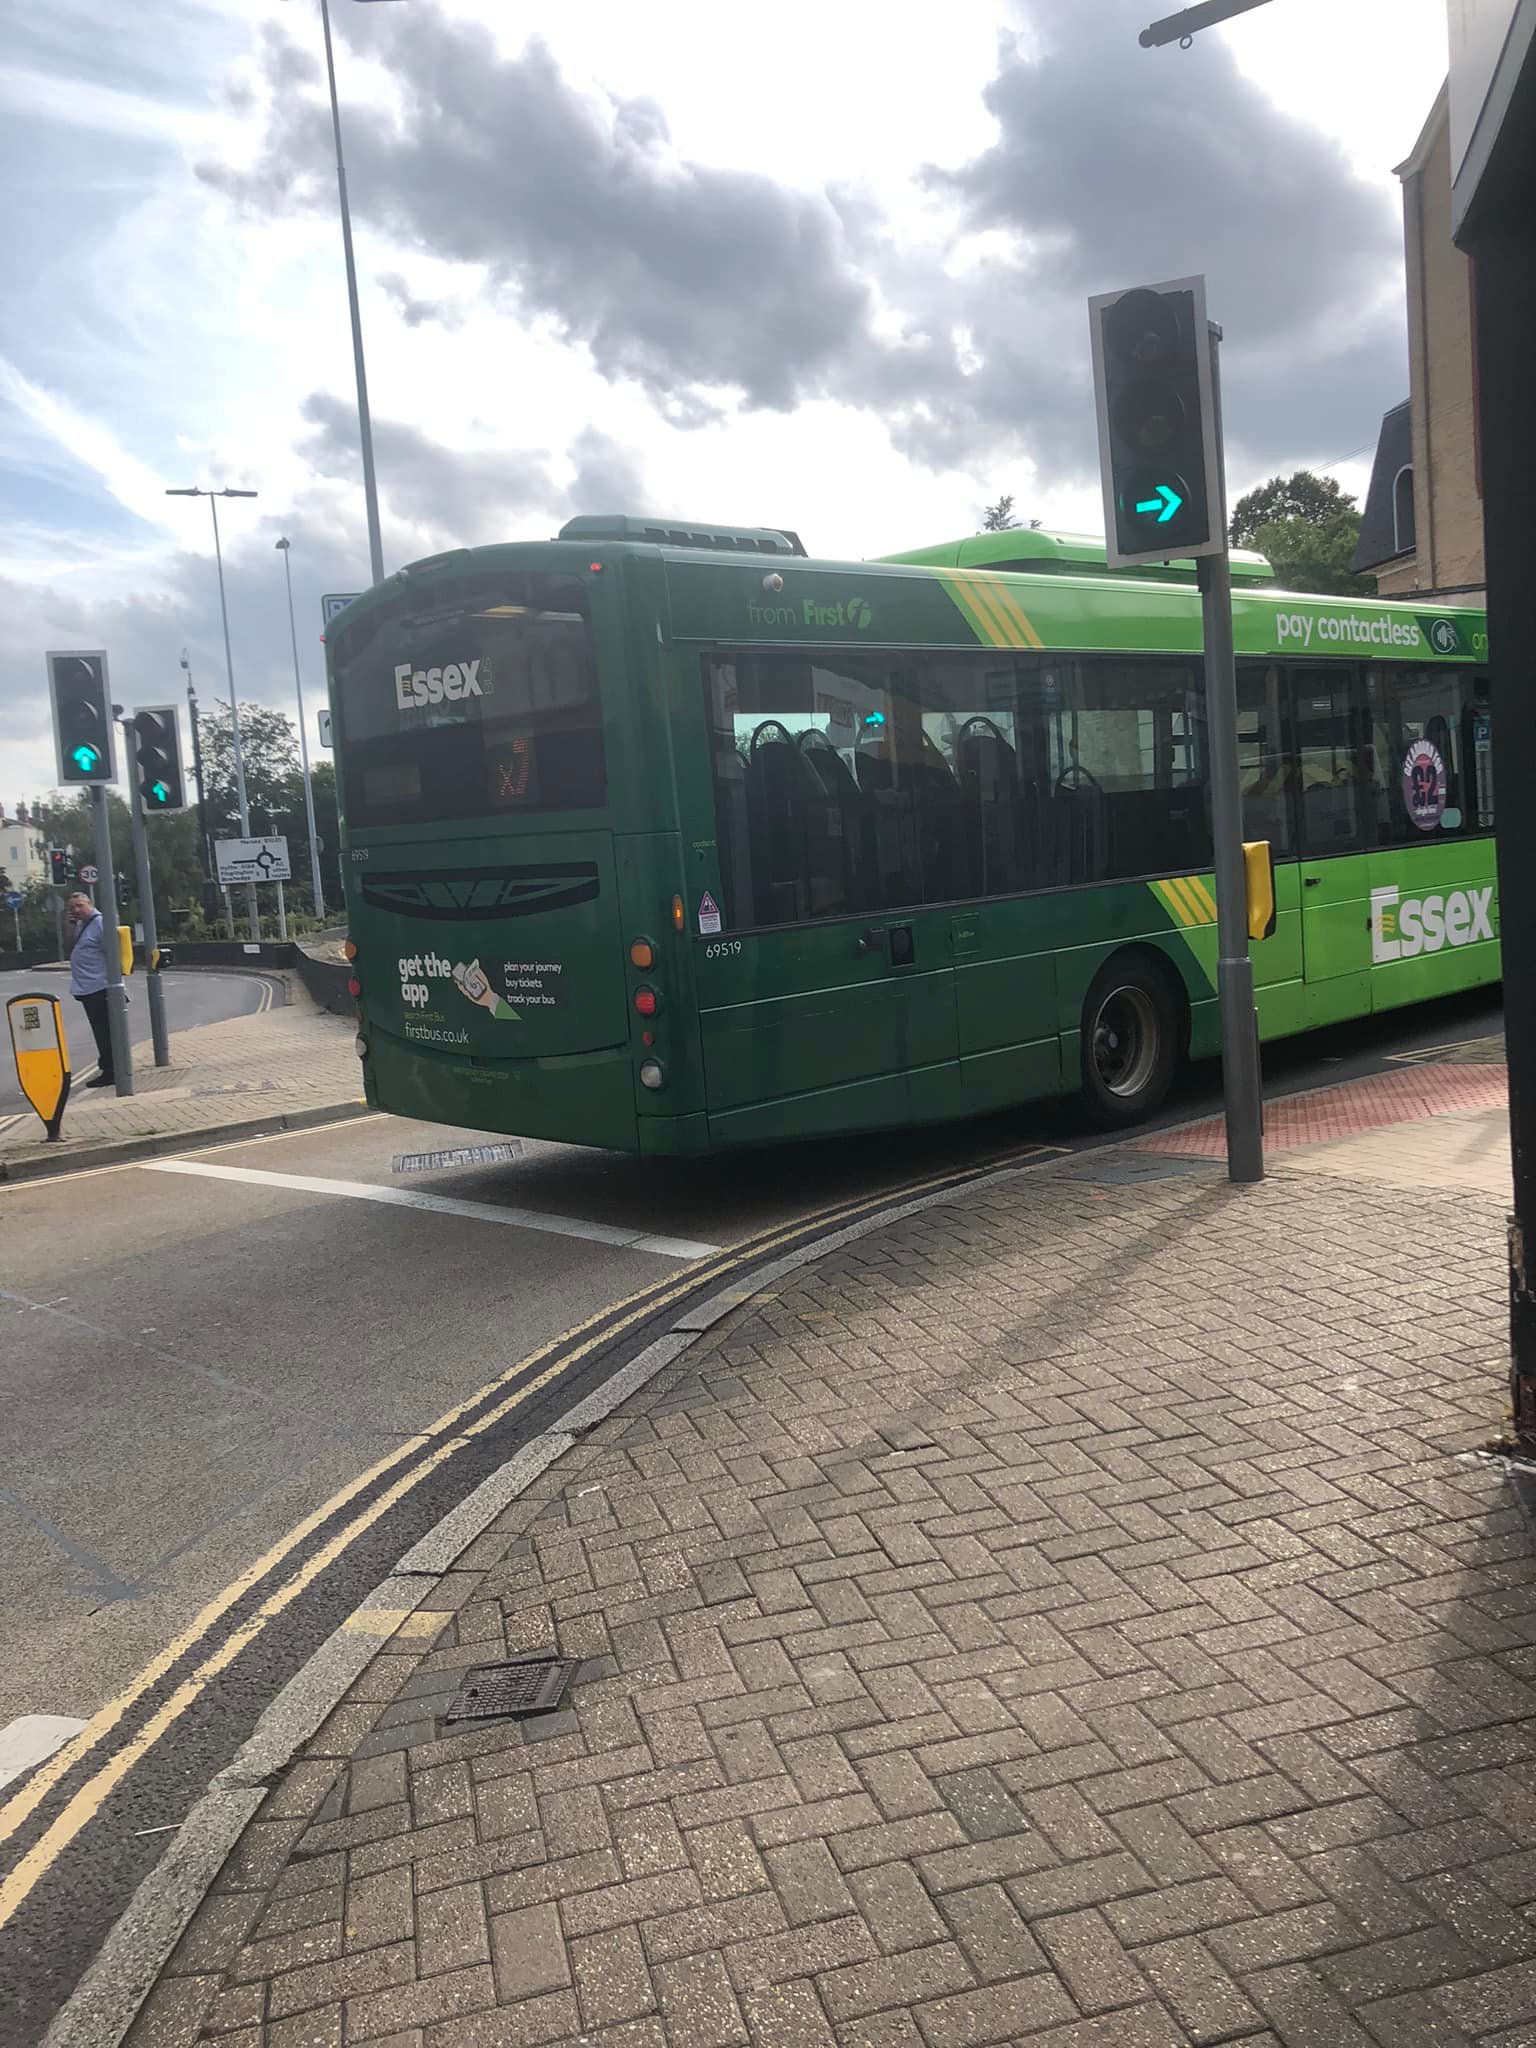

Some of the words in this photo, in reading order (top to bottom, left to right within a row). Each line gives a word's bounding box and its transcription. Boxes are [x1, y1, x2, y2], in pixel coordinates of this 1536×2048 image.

[747, 599, 796, 625] from
[802, 599, 843, 626] First
[1276, 613, 1313, 647] pay
[1317, 615, 1420, 646] contactless
[394, 660, 483, 710] Essex
[80, 870, 97, 879] 30
[1371, 885, 1494, 964] Essex
[705, 940, 742, 958] 69519
[398, 954, 424, 983] get
[424, 952, 451, 978] the
[503, 960, 520, 973] plan
[519, 963, 536, 974] your
[535, 961, 562, 974] journey
[401, 982, 429, 1009] app
[505, 978, 520, 990] buy
[519, 978, 543, 989] tickets
[507, 993, 526, 1004] track
[525, 996, 541, 1005] your
[541, 995, 556, 1005] bus
[405, 1022, 469, 1044] firstbus.co.uk
